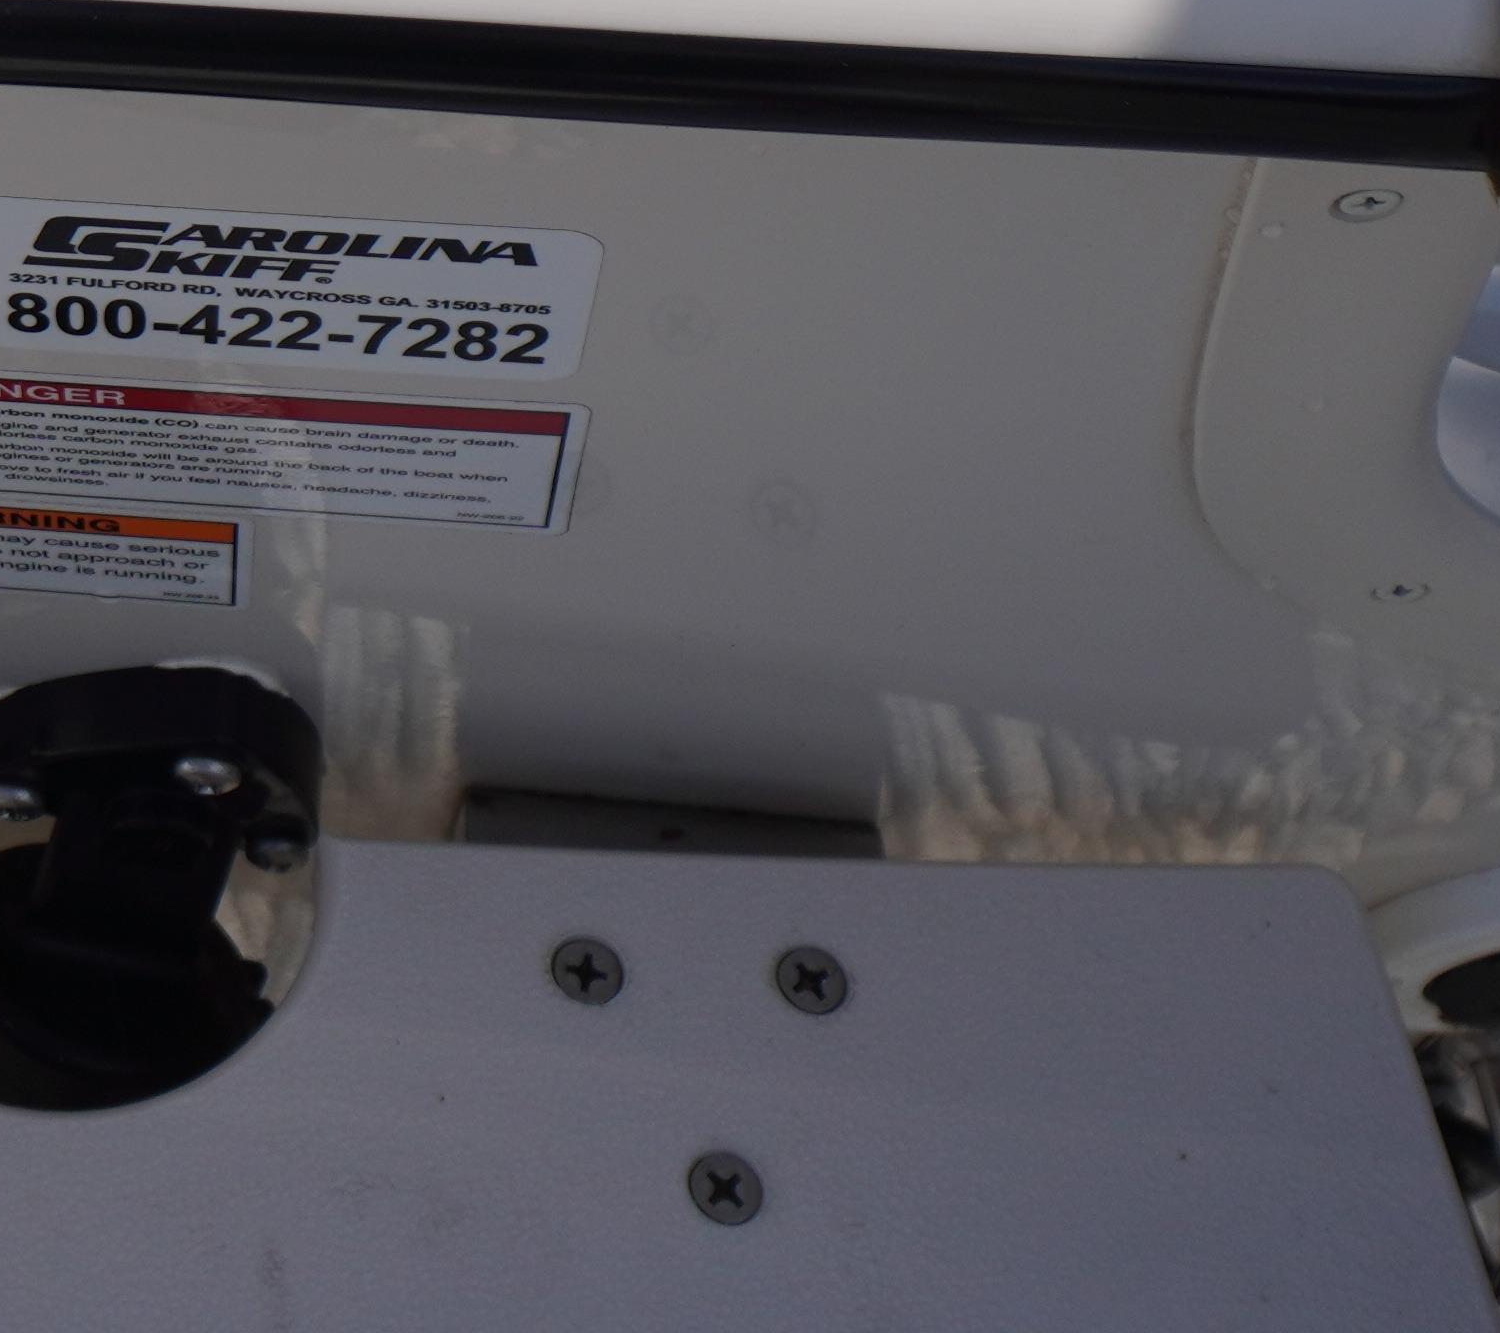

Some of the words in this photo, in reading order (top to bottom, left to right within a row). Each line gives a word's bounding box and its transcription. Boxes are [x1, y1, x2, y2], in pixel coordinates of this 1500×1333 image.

[27, 215, 539, 267] CAROLINA
[9, 272, 60, 287] 3231
[67, 276, 176, 295] FULFORD
[235, 286, 372, 306] WAYCROSS
[427, 298, 551, 316] 31503-8705
[7, 293, 549, 365] 800-422-7282
[45, 424, 79, 433] and
[85, 427, 172, 440] generator
[178, 432, 250, 445] exhaust
[255, 438, 332, 450] contains
[338, 443, 416, 456] odorless
[422, 448, 457, 458] and
[52, 412, 149, 425] monoxide
[155, 418, 199, 429] (CO)
[204, 423, 237, 431] can
[244, 426, 299, 435] cause
[305, 427, 351, 438] brain
[357, 431, 433, 444] damage
[439, 437, 458, 445] or
[463, 438, 519, 449] death.
[63, 433, 124, 445] carbon
[130, 439, 218, 452] monoxide
[36, 464, 52, 474] to
[57, 466, 102, 477] fresh
[107, 470, 130, 479] air
[151, 473, 183, 484] you
[189, 476, 221, 485] feel
[50, 446, 137, 458] monoxide
[142, 452, 171, 461] will
[177, 454, 201, 463] be
[206, 456, 268, 468] around
[274, 460, 303, 470] the
[308, 463, 350, 473] back
[357, 466, 375, 474] of
[380, 467, 408, 477] the
[414, 470, 454, 480] boat
[460, 473, 508, 483] when
[56, 455, 73, 463] or
[79, 457, 175, 472] generators
[180, 464, 209, 472] are
[11, 547, 51, 559] not
[57, 552, 175, 568] approach
[183, 560, 211, 570] or
[45, 537, 120, 550] cause
[128, 543, 220, 558] serious
[76, 564, 96, 575] is
